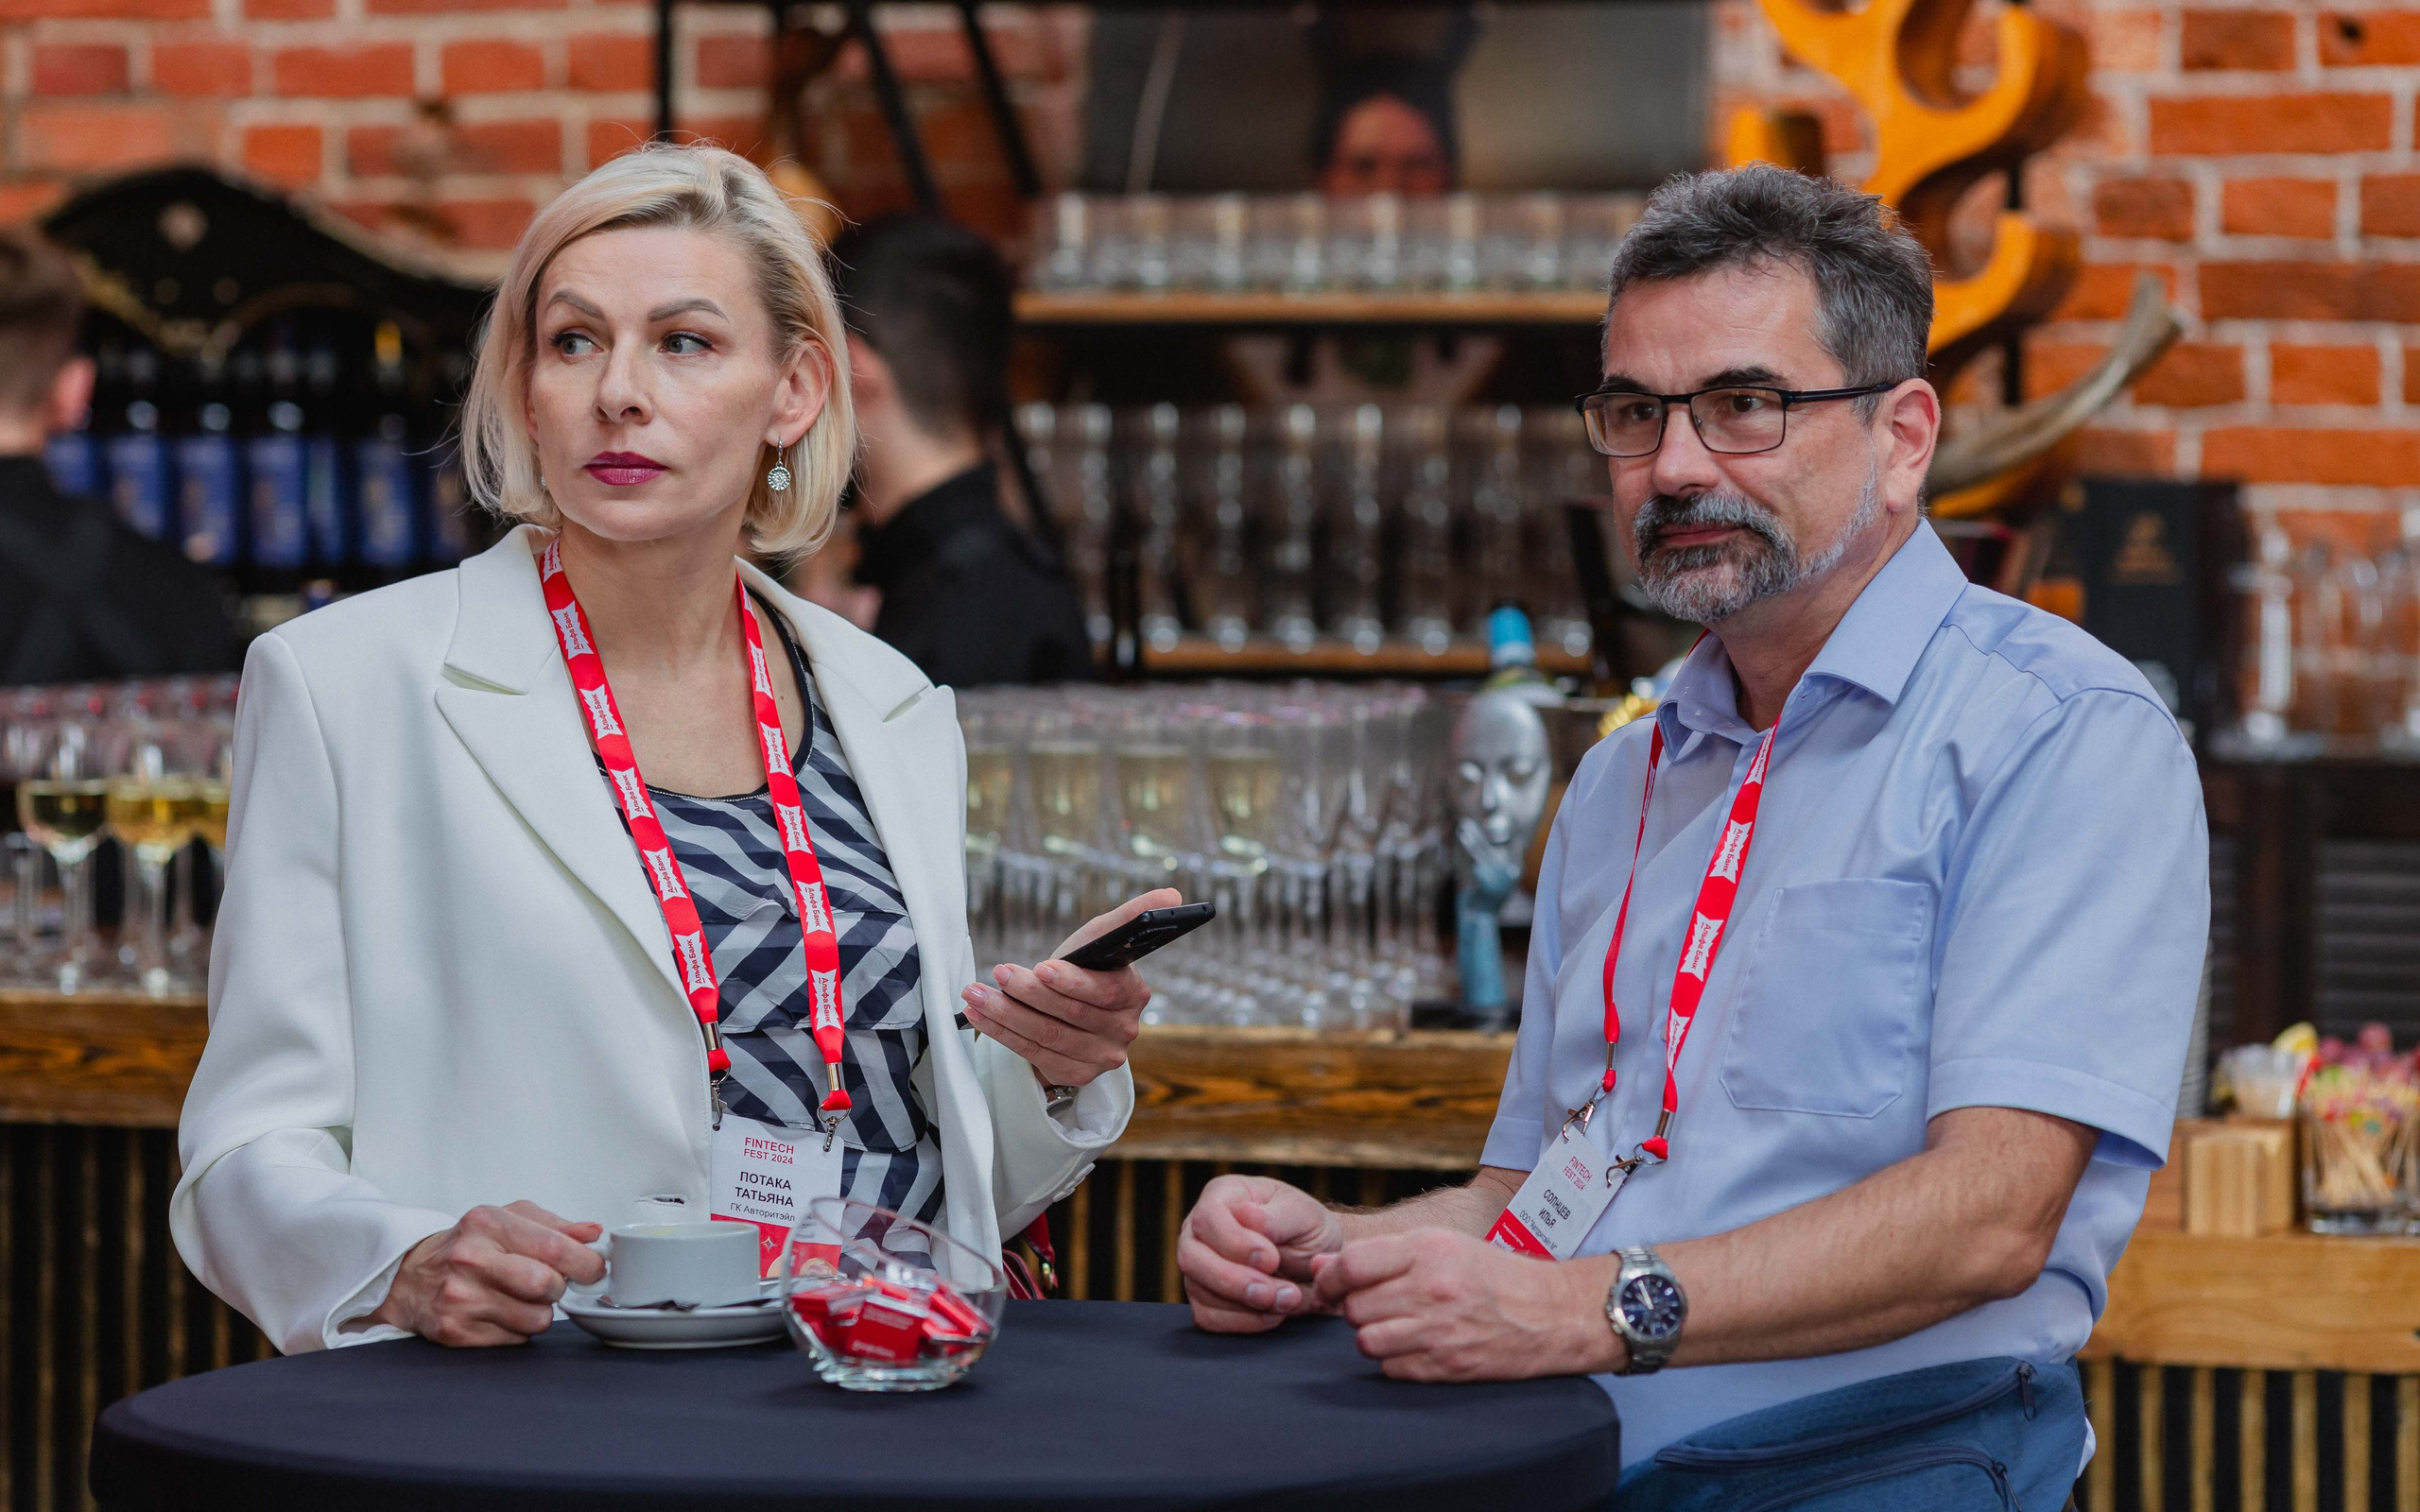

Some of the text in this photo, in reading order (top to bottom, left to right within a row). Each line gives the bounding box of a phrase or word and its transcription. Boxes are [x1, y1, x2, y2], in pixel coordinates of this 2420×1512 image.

[562, 610, 583, 650] Альфа Банк
[591, 693, 613, 730] Альфа Банк
[768, 730, 778, 752] Альфа
[622, 774, 644, 813] Альфа Банк
[786, 809, 802, 848] Альфа Банк
[1721, 828, 1743, 873] Альфа Банк
[655, 854, 678, 893] Альфа Банк
[805, 886, 821, 927] Альфа Банк
[686, 938, 705, 984] Альфа Банк
[1690, 921, 1711, 971] Альфа Банк
[819, 977, 831, 1022] Альфа Банк
[743, 1148, 794, 1165] FEST 2024
[744, 1137, 794, 1155] FINTECH
[739, 1171, 792, 1191] ПОТАКА
[1562, 1166, 1586, 1192] FEST 2024
[1568, 1156, 1593, 1182] FINTECH
[730, 1202, 796, 1223] ГК Авторитэйл
[735, 1186, 794, 1208] ТАТЬЯНА
[1543, 1189, 1571, 1220] СОЛНЦЕВ
[1519, 1210, 1530, 1224] ООО
[1538, 1207, 1557, 1228] ИЛЬЯ
